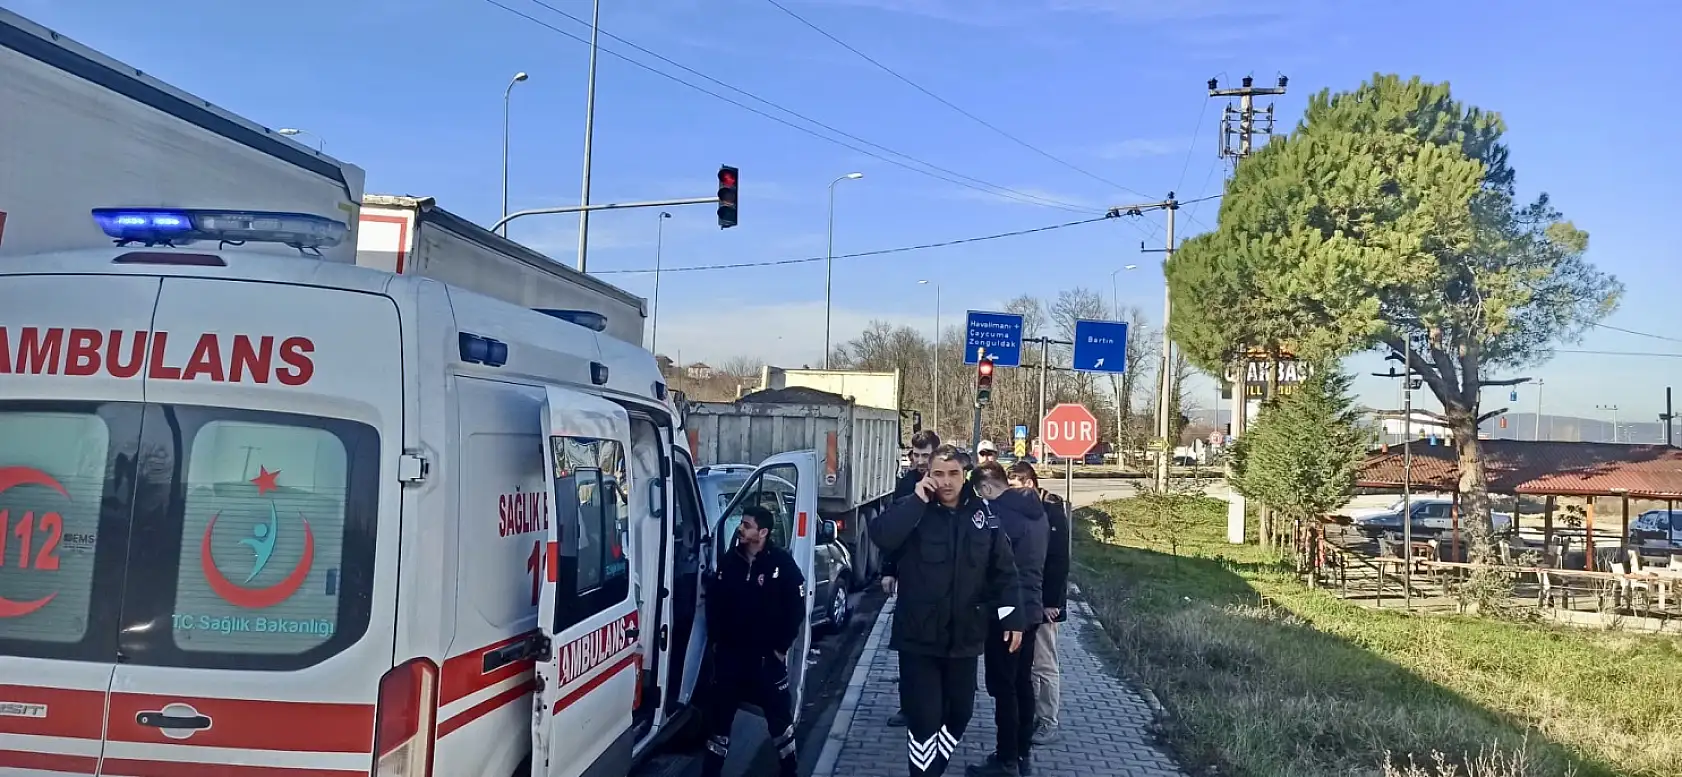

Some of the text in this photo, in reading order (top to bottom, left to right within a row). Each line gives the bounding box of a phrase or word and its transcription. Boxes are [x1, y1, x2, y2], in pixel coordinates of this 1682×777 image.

[969, 329, 1009, 339] Çaycuma
[969, 338, 1016, 348] Zonguldak
[1087, 335, 1114, 344] Bartın
[0, 326, 315, 386] MBULANS
[1047, 420, 1093, 441] DUR
[499, 485, 540, 538] SAĞLIK
[200, 615, 250, 634] Sağlık
[255, 617, 334, 637] Bakanlığı
[560, 616, 626, 687] AMBULANS
